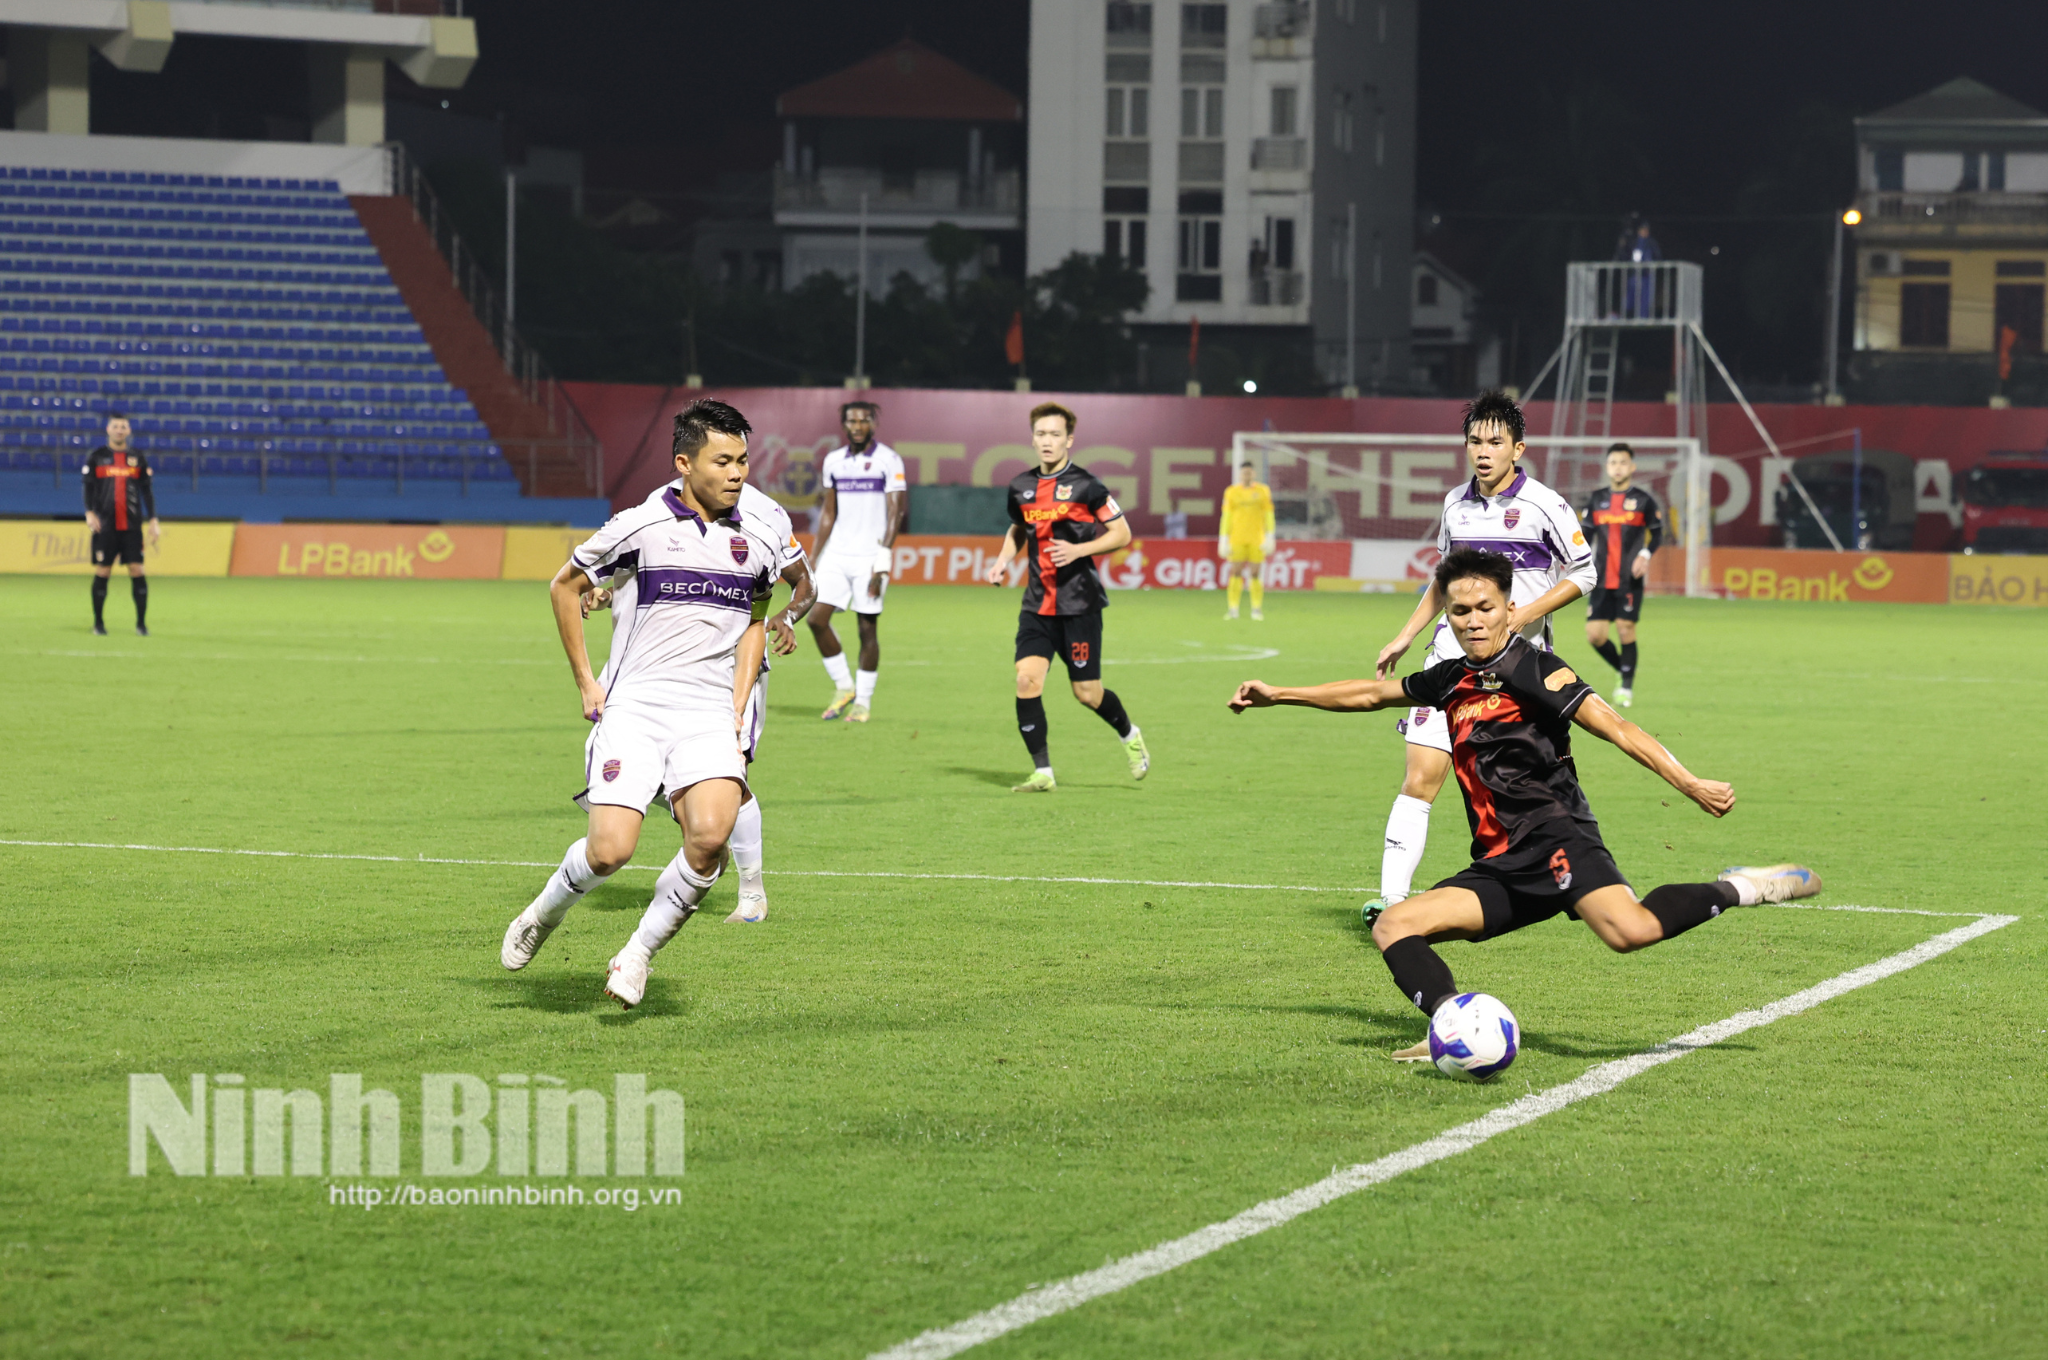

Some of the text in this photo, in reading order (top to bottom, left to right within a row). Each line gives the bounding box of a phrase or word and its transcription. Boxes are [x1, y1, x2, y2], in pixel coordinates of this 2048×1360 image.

[278, 542, 414, 576] LPBank
[892, 546, 1029, 588] PT Play
[1154, 558, 1216, 587] GIA
[1954, 566, 2026, 602] BẢO
[1071, 642, 1089, 661] 28
